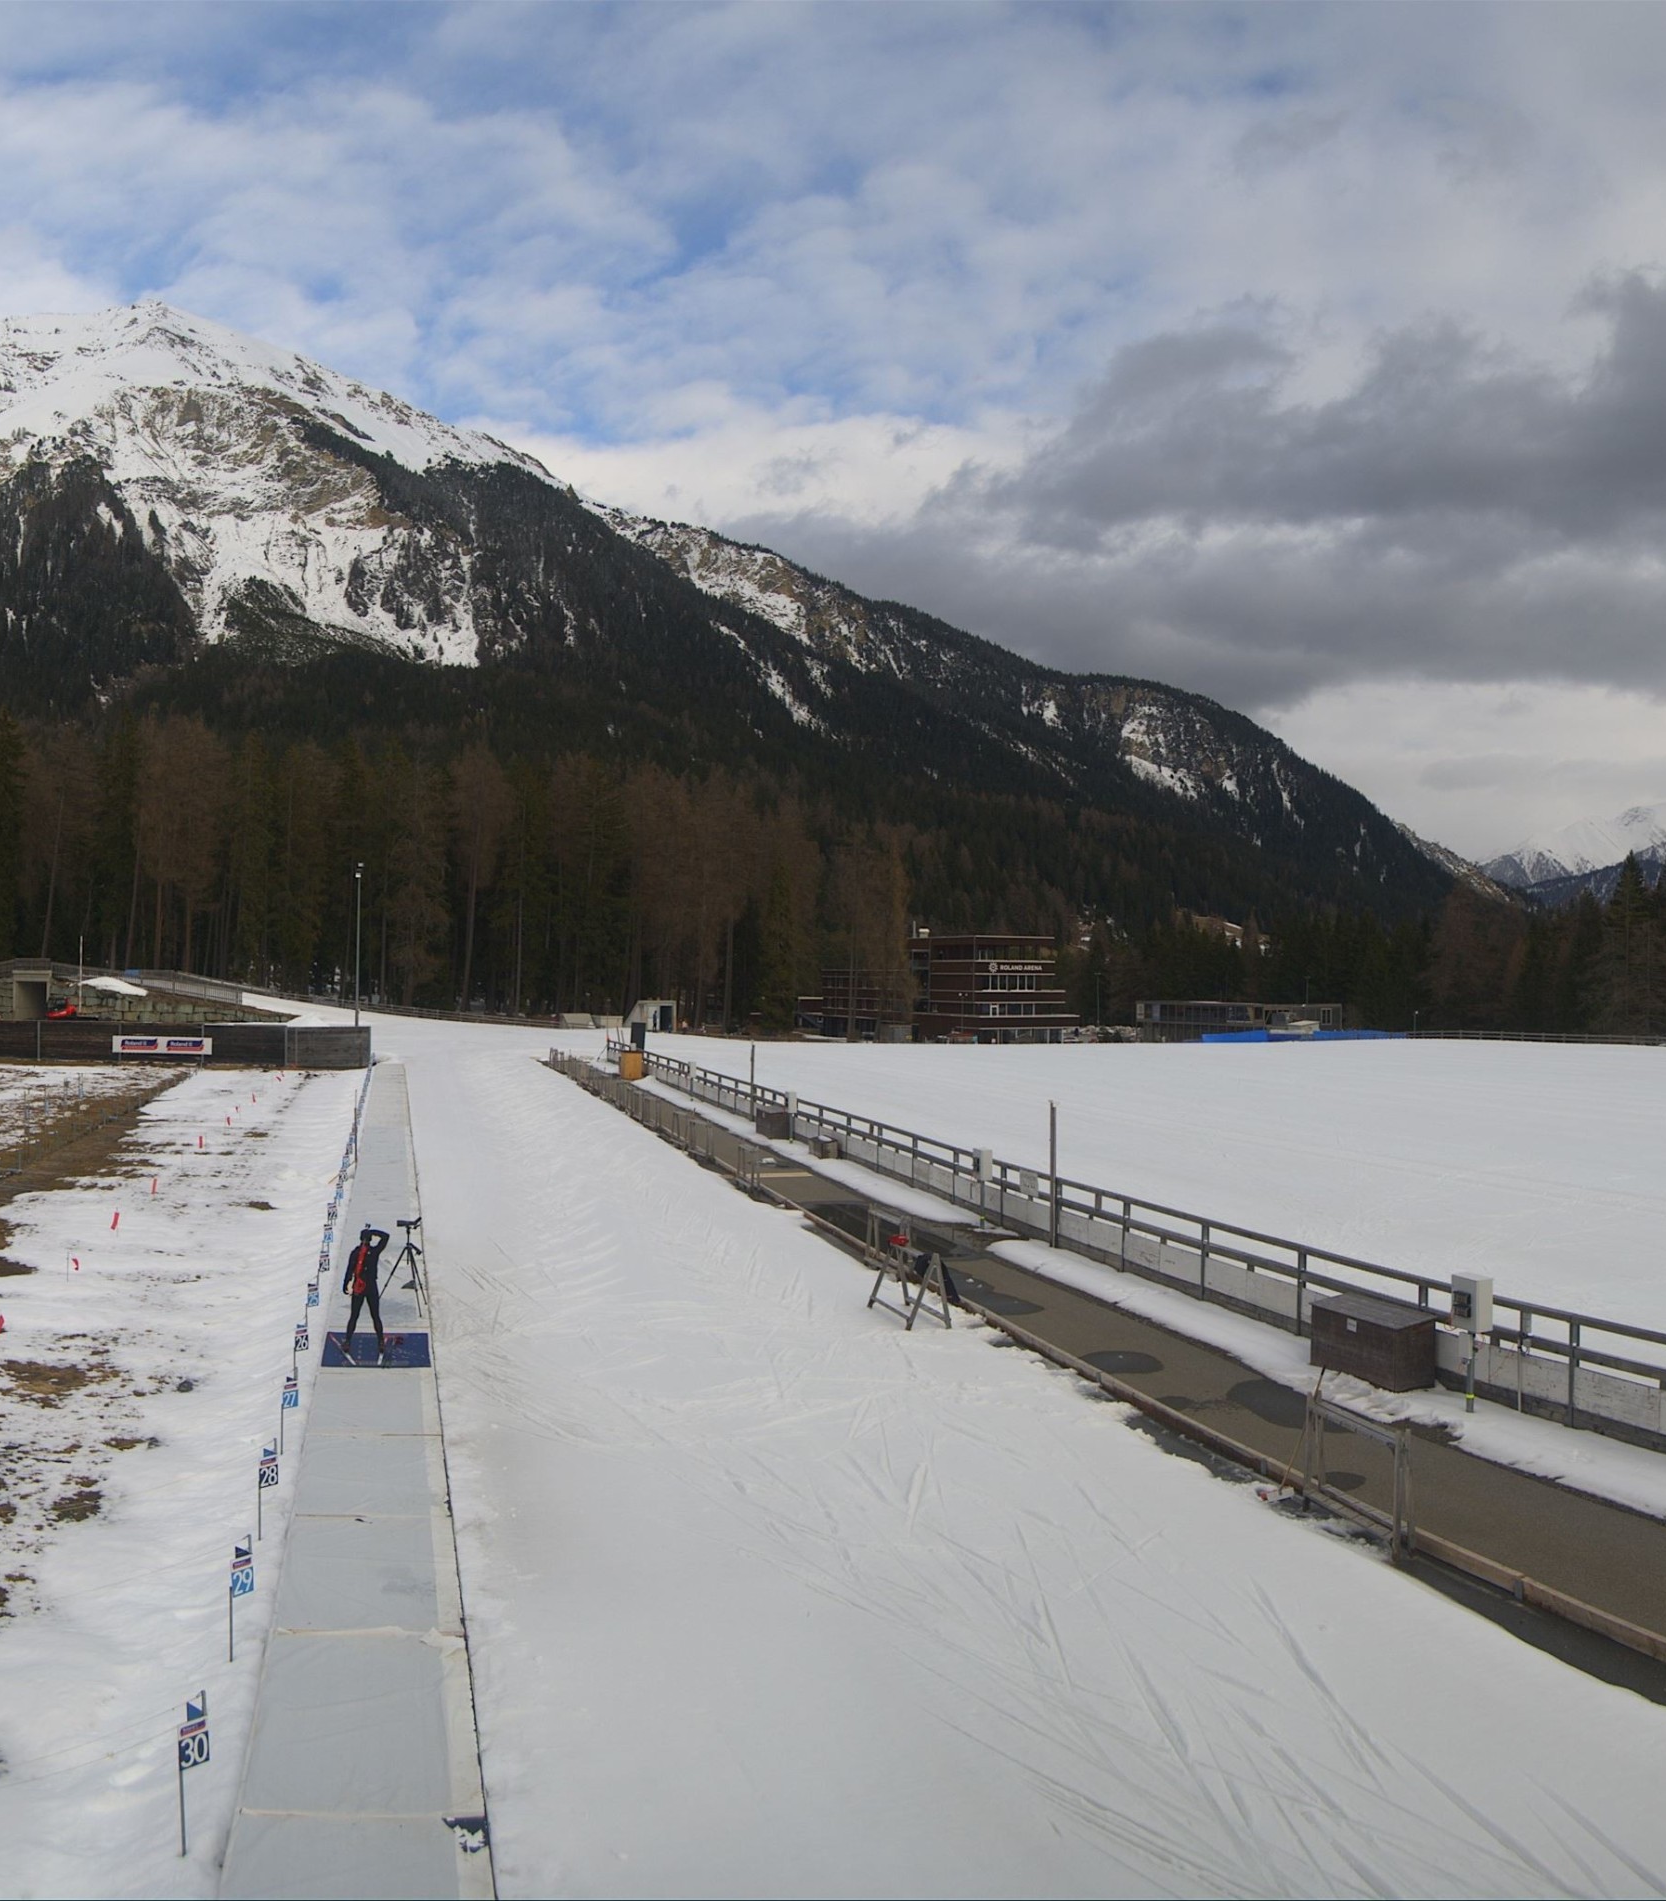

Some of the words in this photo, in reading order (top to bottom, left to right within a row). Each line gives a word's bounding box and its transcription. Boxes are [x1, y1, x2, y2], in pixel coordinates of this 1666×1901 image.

[296, 1335, 308, 1350] 26
[284, 1391, 297, 1408] 27
[259, 1465, 278, 1488] 28
[233, 1568, 253, 1596] 29
[180, 1732, 209, 1768] 30
